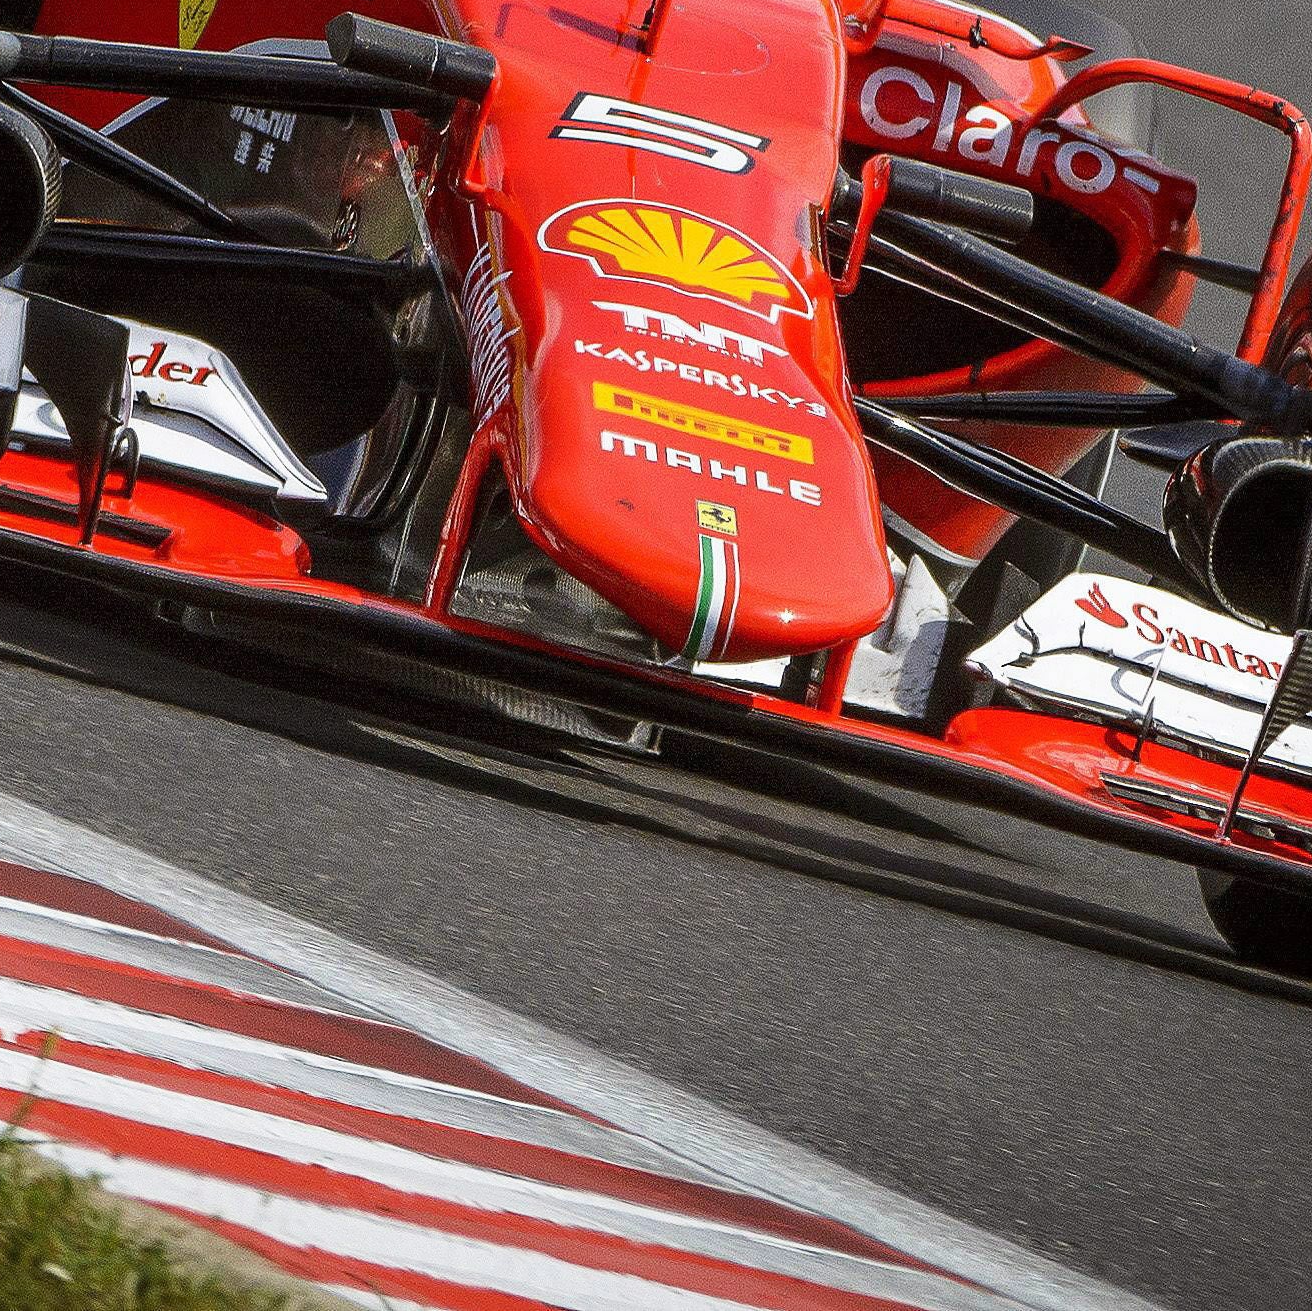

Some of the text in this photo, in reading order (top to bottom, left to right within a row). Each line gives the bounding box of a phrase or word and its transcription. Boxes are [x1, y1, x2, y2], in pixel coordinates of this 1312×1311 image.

[547, 91, 772, 176] 5
[860, 65, 1117, 194] Claro
[590, 300, 790, 362] TNT
[573, 338, 806, 409] KASPERSKY
[600, 429, 823, 507] MAHLE
